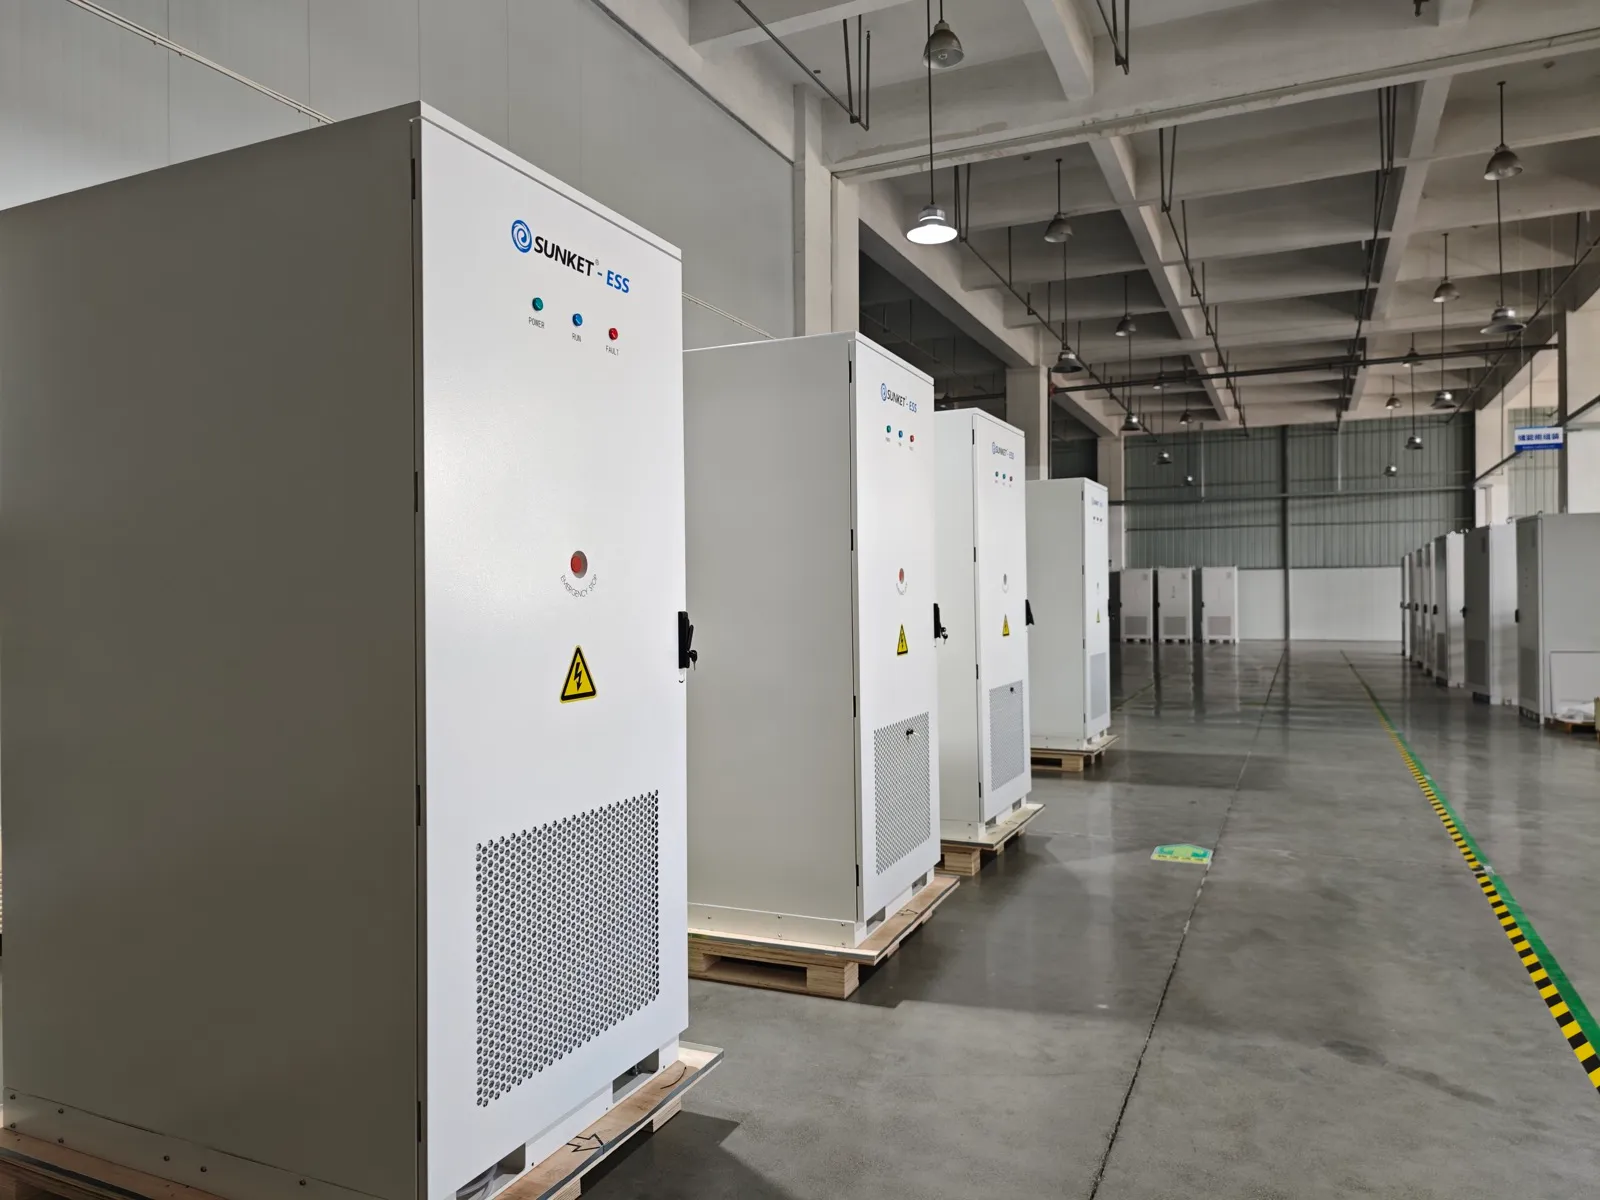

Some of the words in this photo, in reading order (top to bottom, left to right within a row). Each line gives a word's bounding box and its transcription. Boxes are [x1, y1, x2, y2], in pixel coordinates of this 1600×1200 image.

[606, 269, 630, 293] ESS
[528, 316, 545, 329] POWER
[571, 332, 582, 342] RUN
[605, 345, 619, 356] FAULT
